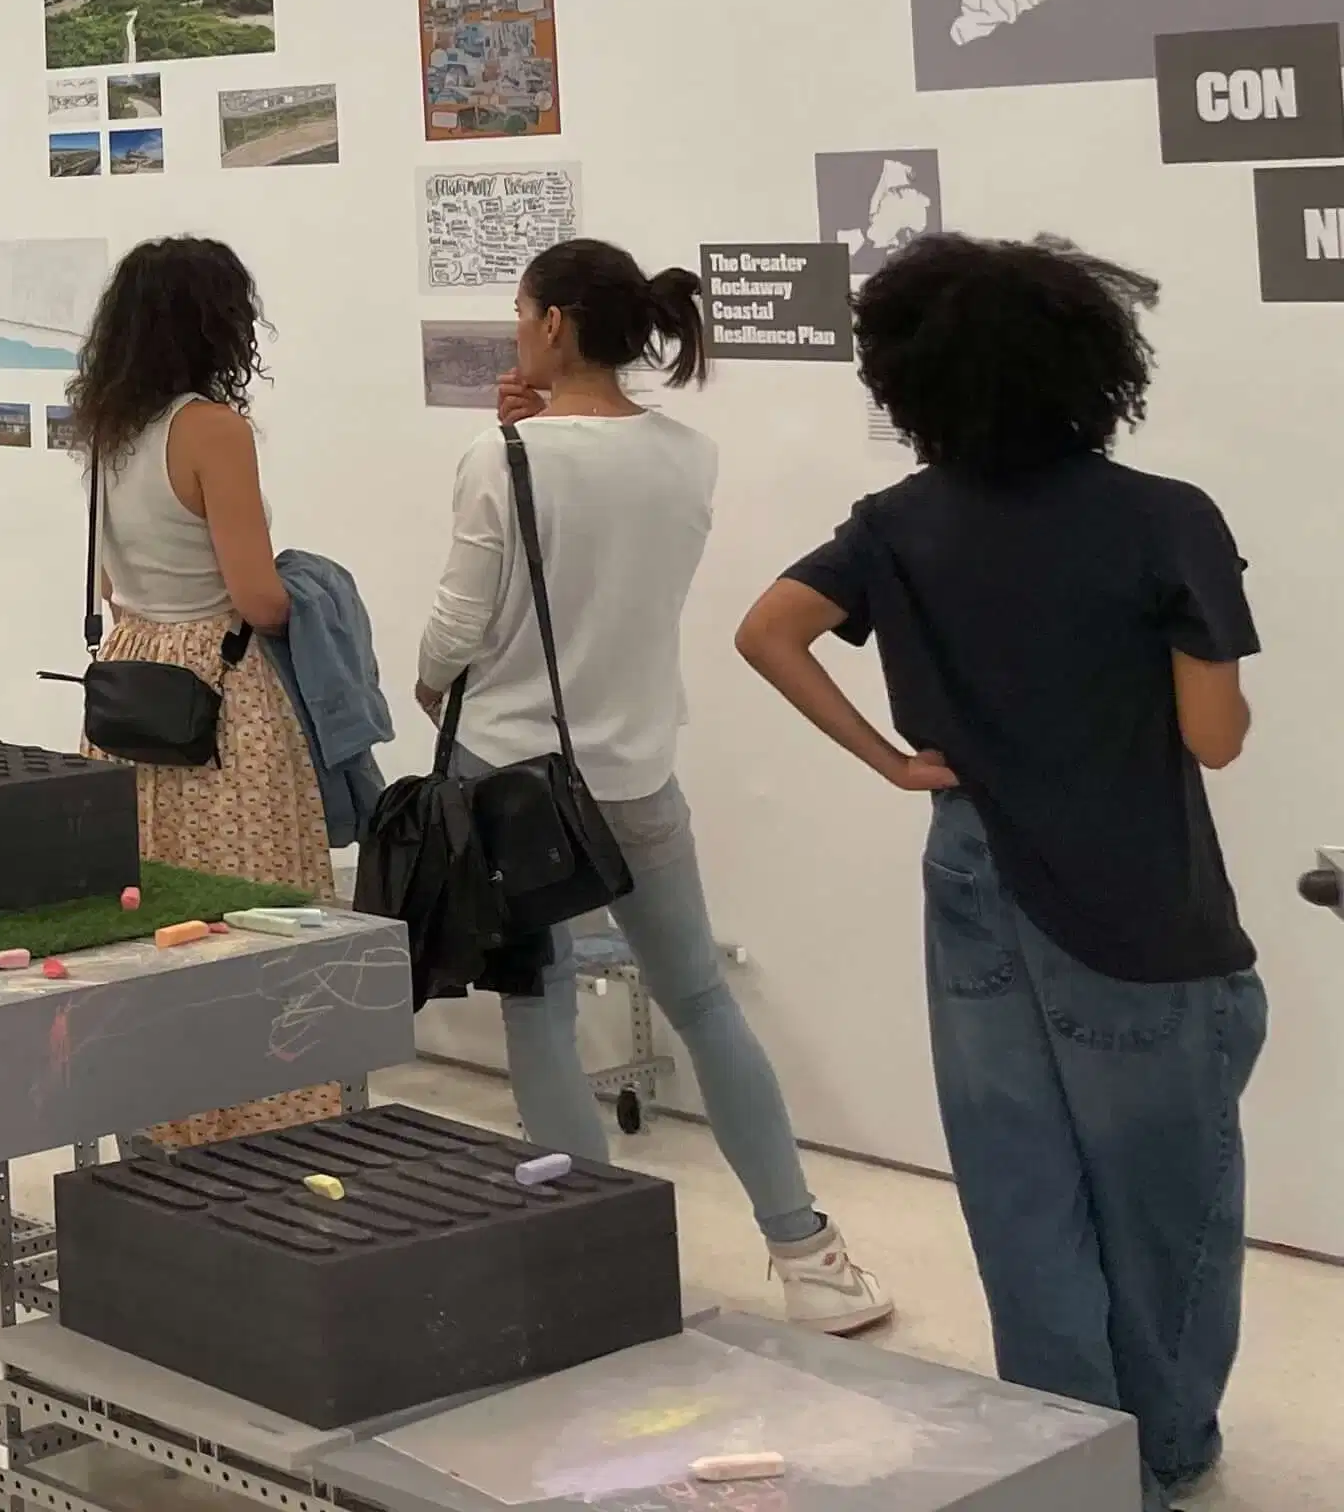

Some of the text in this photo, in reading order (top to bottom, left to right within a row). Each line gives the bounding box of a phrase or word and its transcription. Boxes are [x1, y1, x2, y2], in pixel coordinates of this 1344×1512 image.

[1195, 66, 1298, 123] CON
[1302, 207, 1344, 260] N
[709, 253, 807, 273] The Greater
[710, 276, 793, 300] Rockaway
[711, 300, 774, 320] Coastal
[713, 325, 836, 346] Resilience Plan
